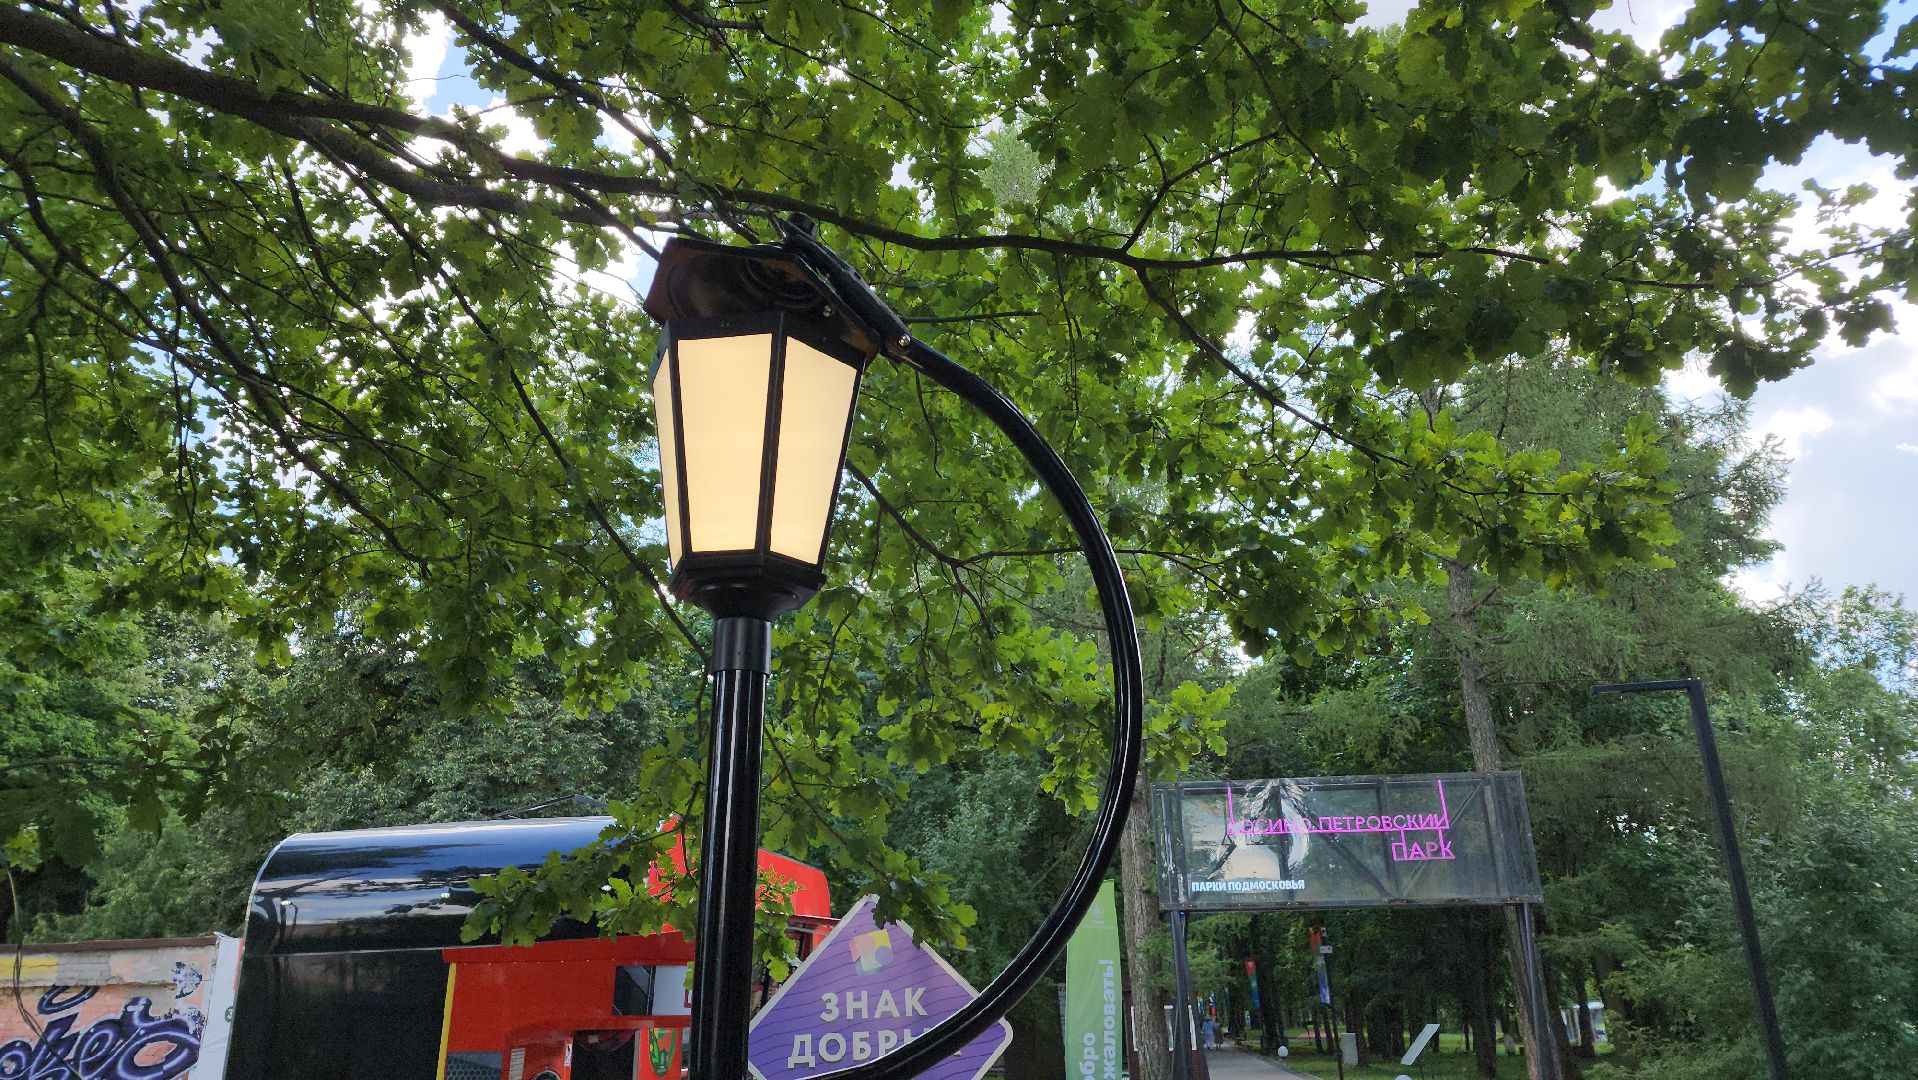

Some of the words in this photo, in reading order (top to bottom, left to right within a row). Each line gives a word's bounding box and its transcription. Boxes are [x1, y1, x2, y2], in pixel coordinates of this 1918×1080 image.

[1391, 841, 1456, 861] ПАРК
[1191, 881, 1226, 892] ПАРКИ
[1227, 879, 1305, 892] ПОДМОСКОВЬЯ
[820, 987, 928, 1022] ЗНАК
[787, 1028, 961, 1069] ДОБР
